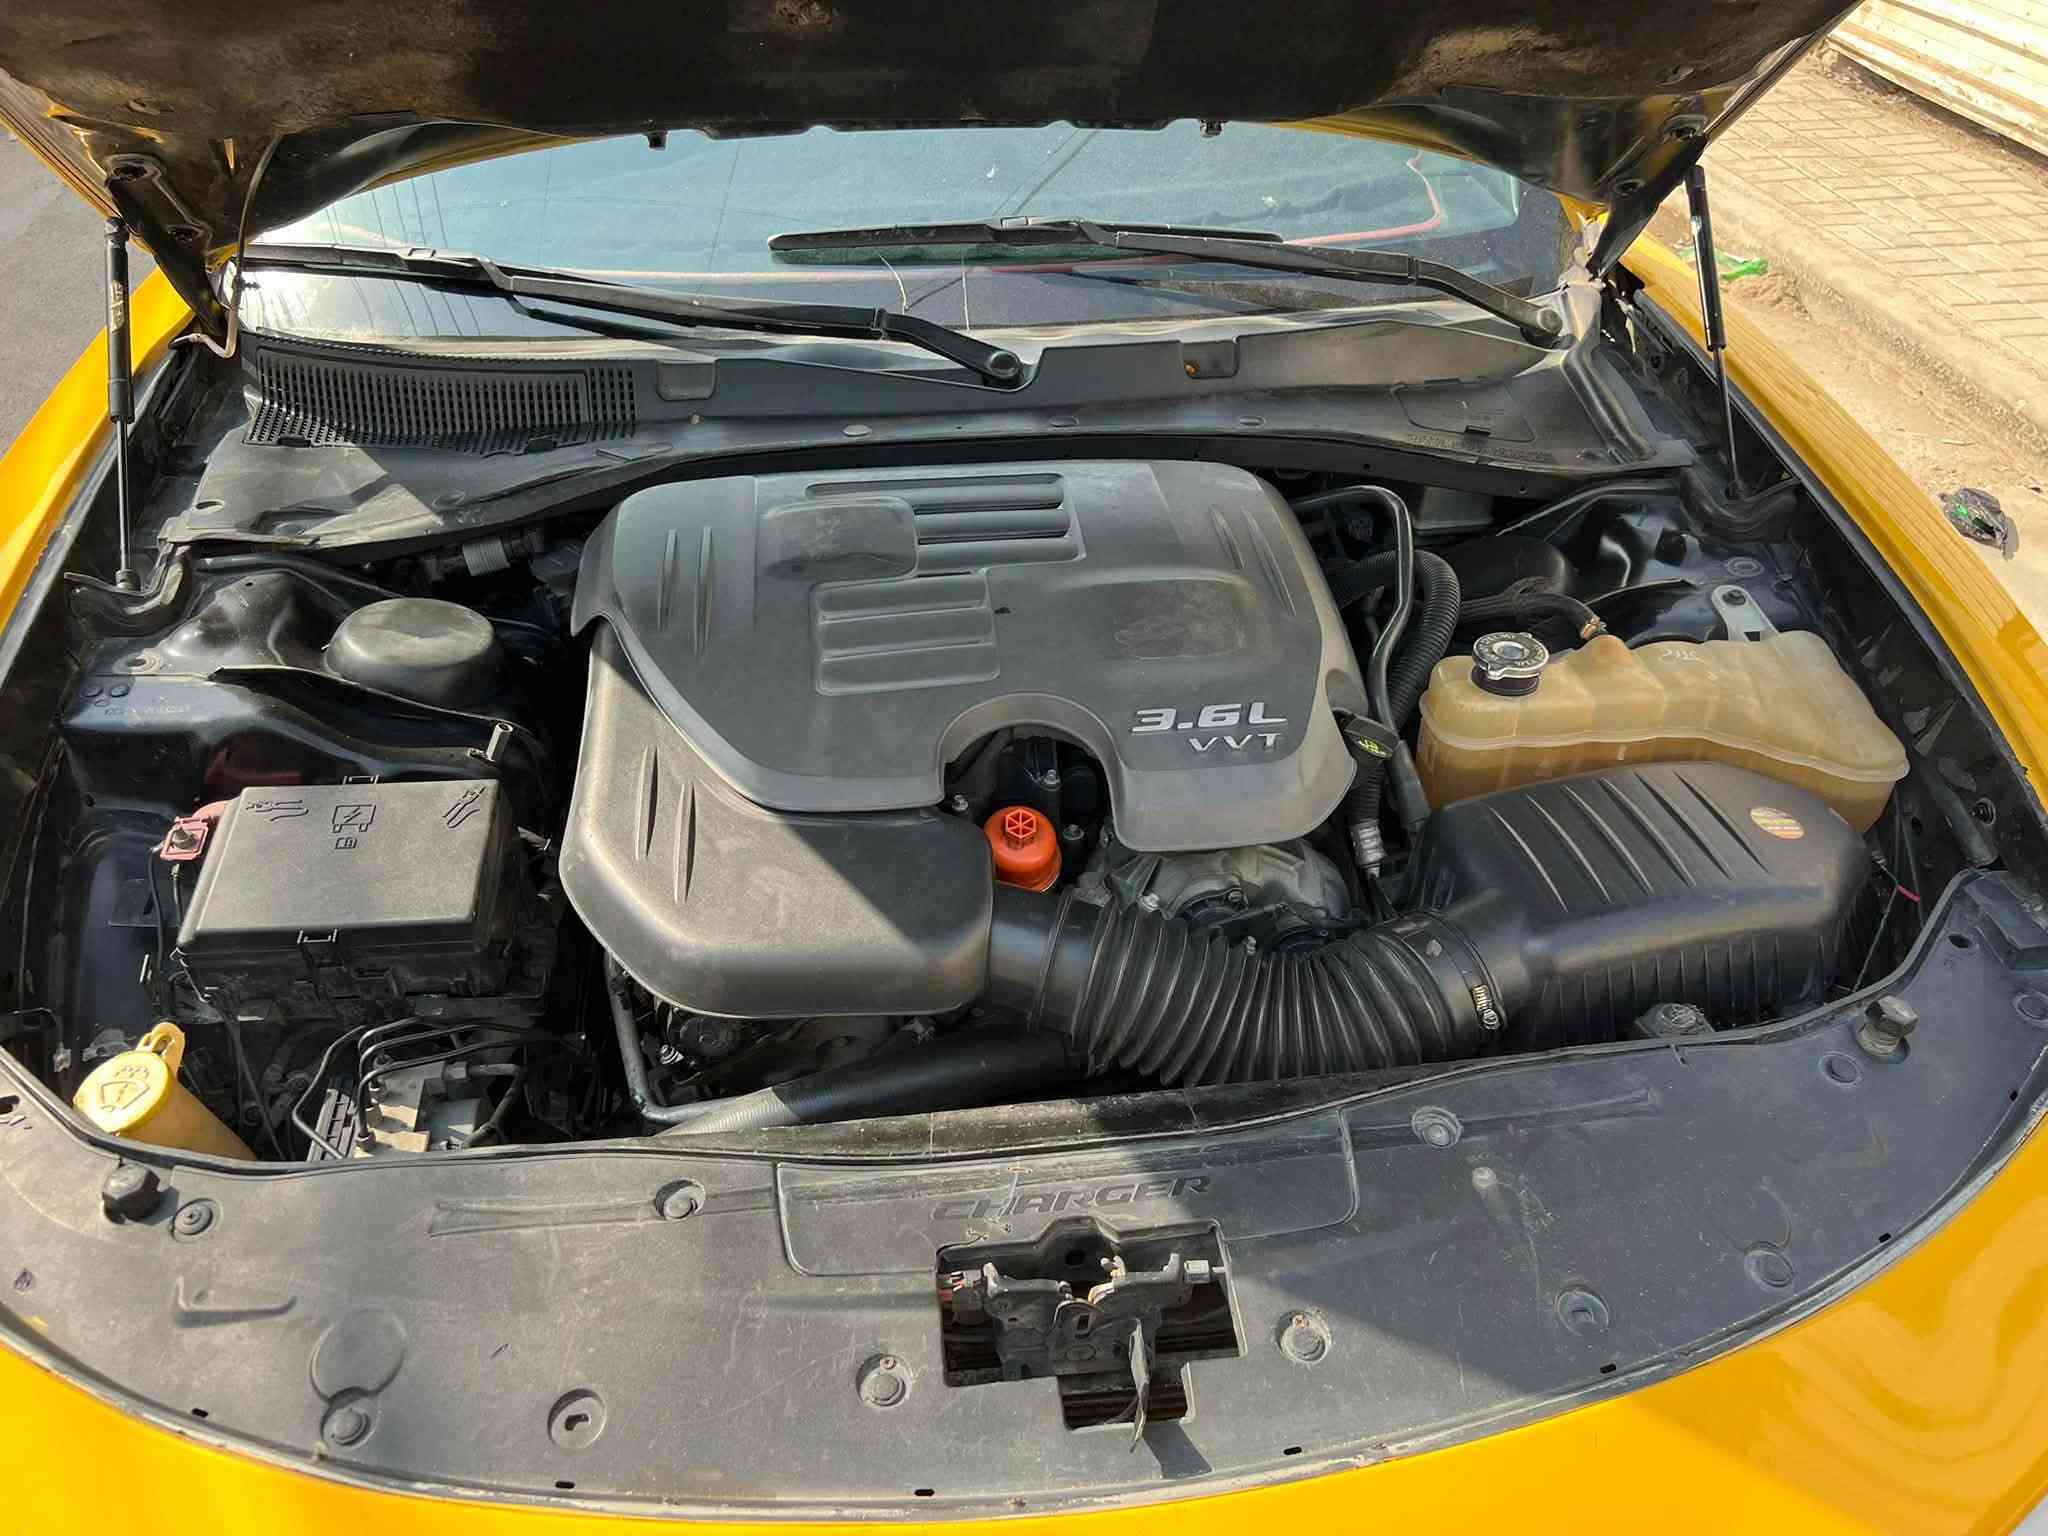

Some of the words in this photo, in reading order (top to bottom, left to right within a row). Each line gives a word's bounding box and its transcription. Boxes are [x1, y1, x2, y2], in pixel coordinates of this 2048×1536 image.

[1131, 701, 1288, 733] 3.6L
[1188, 733, 1283, 752] VVT
[931, 1175, 1211, 1220] CHARGER
